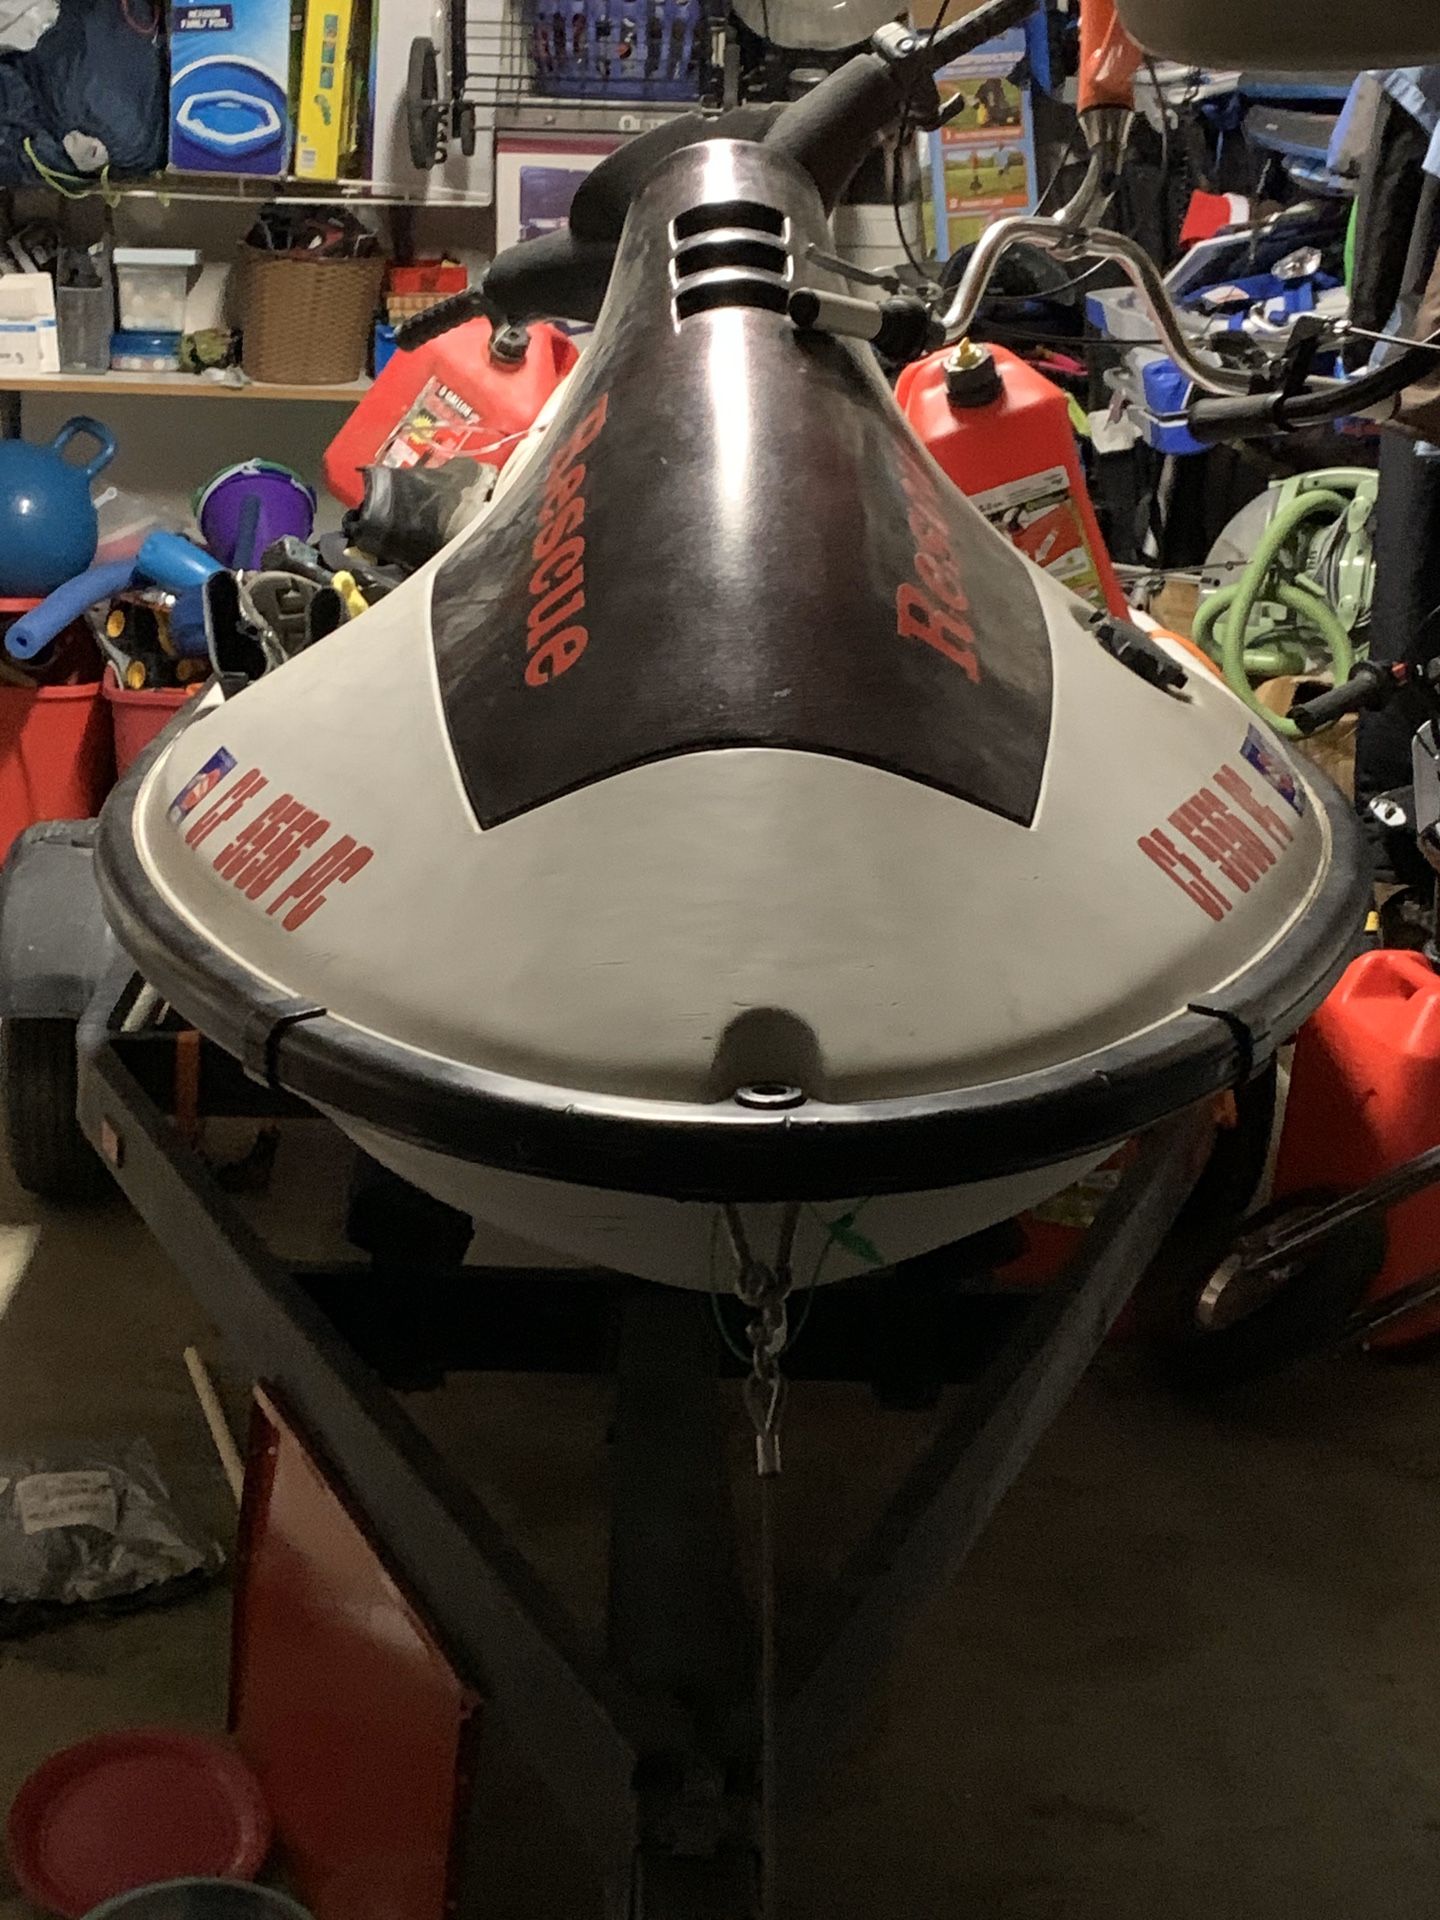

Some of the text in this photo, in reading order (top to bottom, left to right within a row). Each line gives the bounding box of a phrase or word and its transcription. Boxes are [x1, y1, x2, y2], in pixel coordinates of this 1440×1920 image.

[524, 392, 609, 688] Rescue
[185, 768, 374, 932] CF 5556 PC
[1136, 827, 1233, 922] CF
[1167, 787, 1277, 893] 5556
